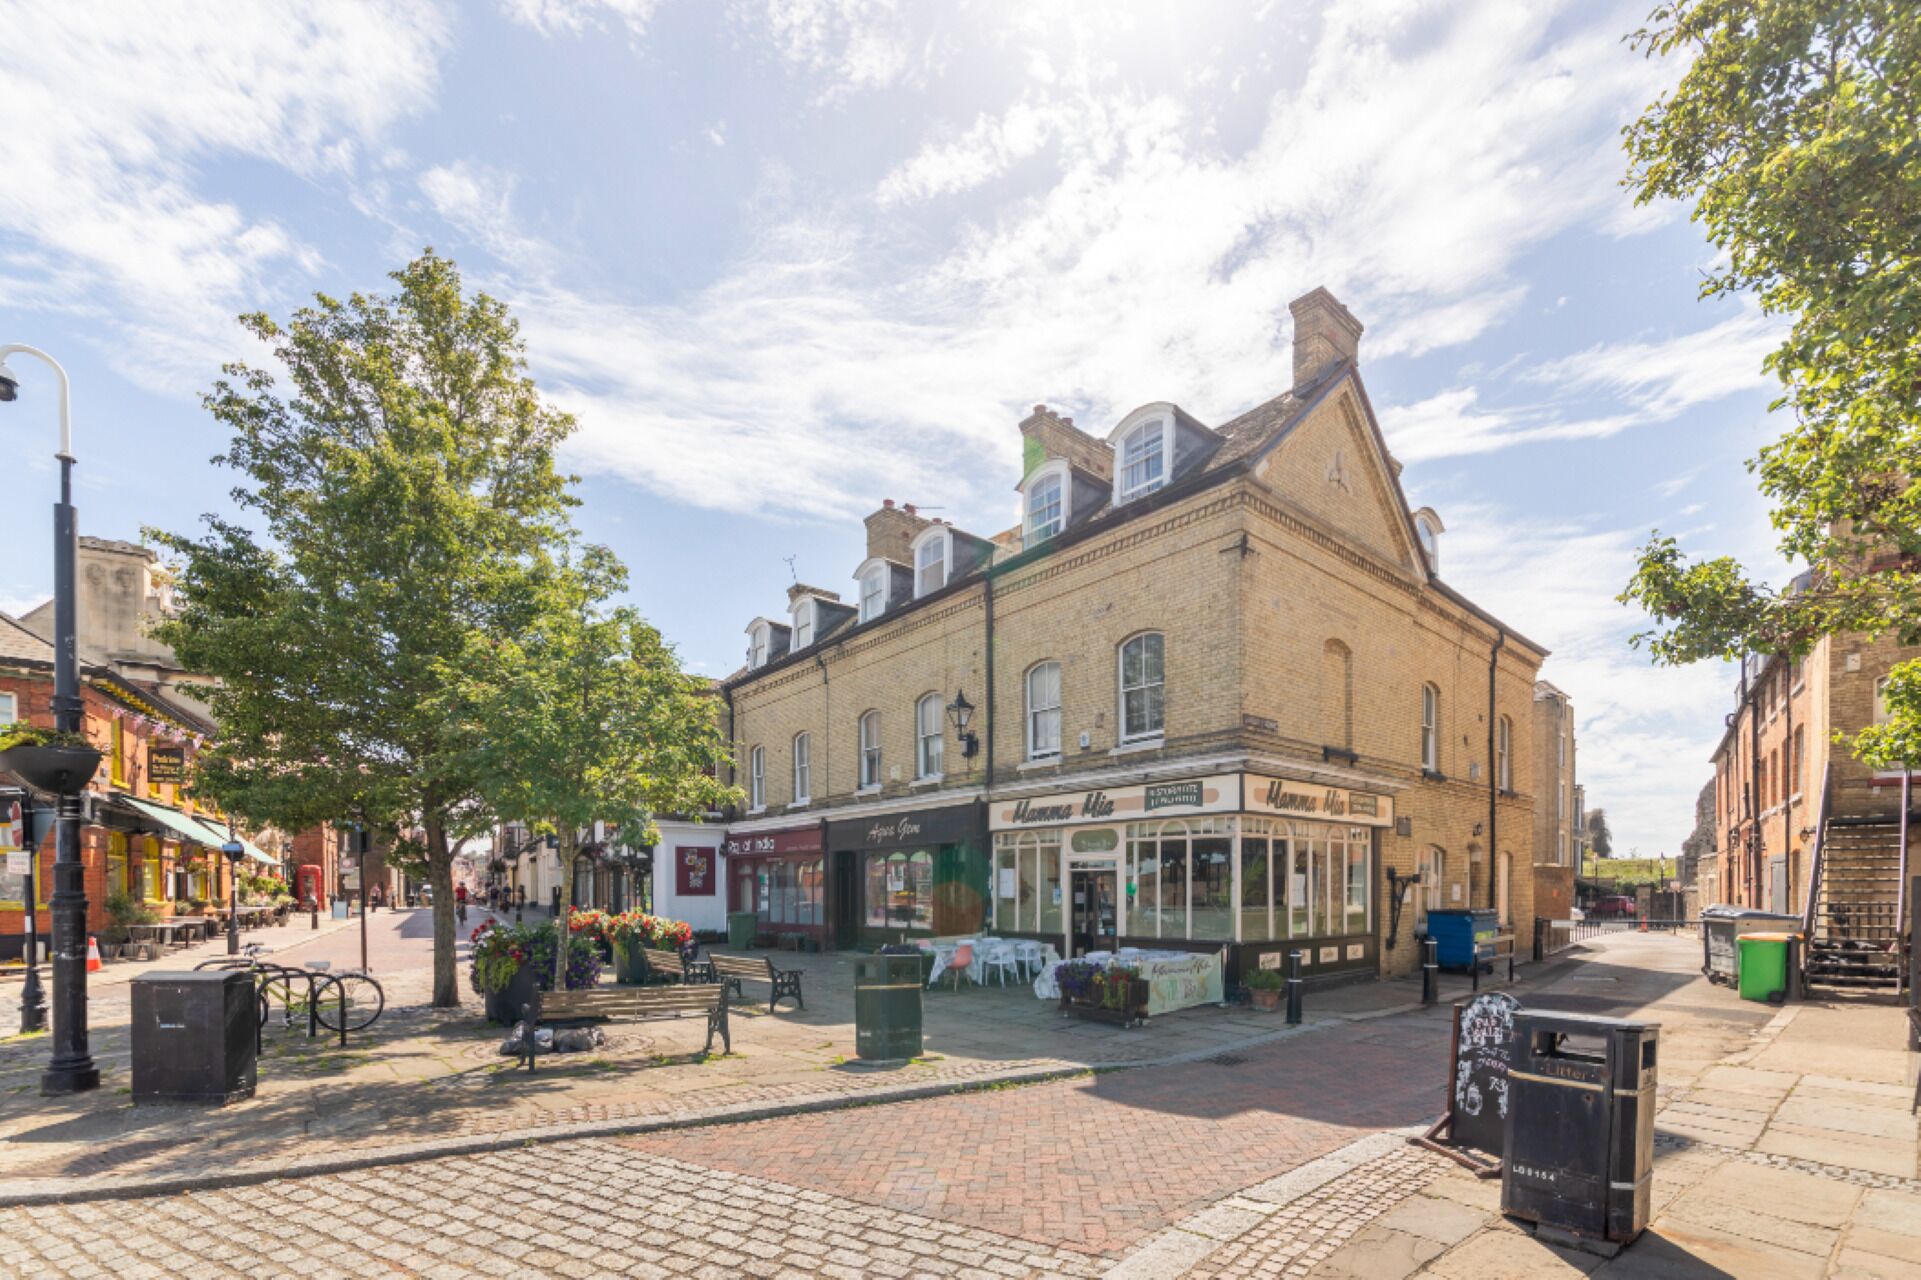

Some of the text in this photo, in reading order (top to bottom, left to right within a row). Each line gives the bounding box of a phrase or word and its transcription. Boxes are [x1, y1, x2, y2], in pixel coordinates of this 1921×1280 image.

[1012, 791, 1115, 824] Mamma Mia
[1267, 780, 1317, 813] Mamma
[1323, 789, 1345, 816] Mia
[1545, 1063, 1588, 1081] Litter
